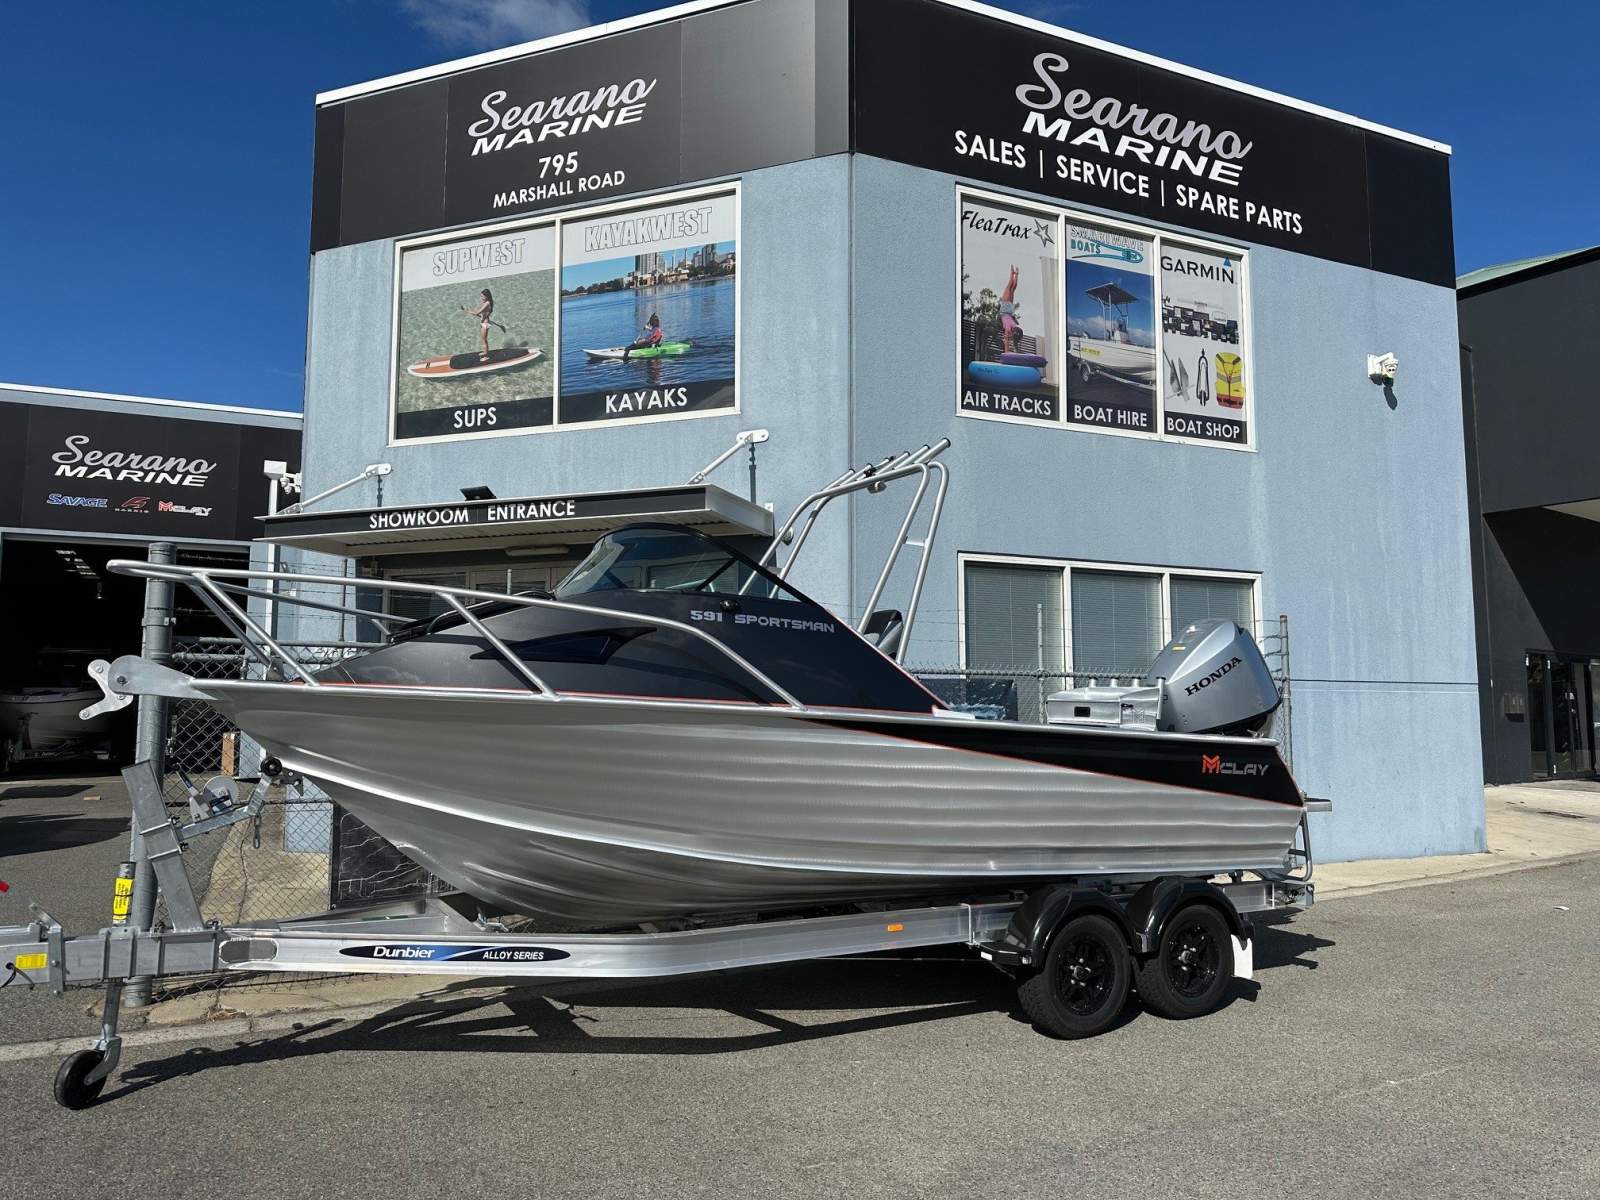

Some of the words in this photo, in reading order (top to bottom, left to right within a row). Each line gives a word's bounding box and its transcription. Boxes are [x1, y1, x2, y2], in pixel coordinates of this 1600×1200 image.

[467, 78, 657, 137] Searano
[1015, 52, 1253, 160] Searano
[471, 102, 647, 156] MARINE
[1022, 111, 1244, 186] MARINE
[538, 151, 579, 179] 795
[493, 180, 574, 208] MARSHALL
[578, 170, 626, 193] ROAD
[954, 130, 1026, 169] SALES
[1056, 154, 1150, 198] SERVICE
[1176, 183, 1239, 220] SPARE
[1245, 201, 1303, 235] PARTS
[584, 206, 713, 252] KAYAKWEST
[960, 210, 1033, 240] FleaTrax
[432, 237, 526, 277] SUPWEST
[1071, 239, 1101, 254] BOATS
[1161, 256, 1234, 284] GARMIN
[605, 387, 688, 414] KAYAKS
[963, 390, 990, 409] AIR
[993, 393, 1051, 416] TRACKS
[1074, 403, 1113, 423] BOAT
[1117, 408, 1148, 427] HIRE
[453, 407, 497, 429] SUPS
[1167, 417, 1202, 436] BOAT
[1206, 422, 1240, 439] SHOP
[51, 435, 217, 474] Searano
[54, 464, 209, 487] MARINE
[47, 493, 108, 508] SAVAGE
[368, 507, 469, 530] SHOWROOM
[487, 499, 576, 522] ENTRANCE
[690, 610, 723, 622] 591
[734, 613, 835, 633] SPORTSMAN
[1184, 655, 1242, 697] HONDA
[373, 946, 435, 959] Dunbier
[483, 951, 513, 960] ALLOY
[512, 951, 545, 961] SERIES
